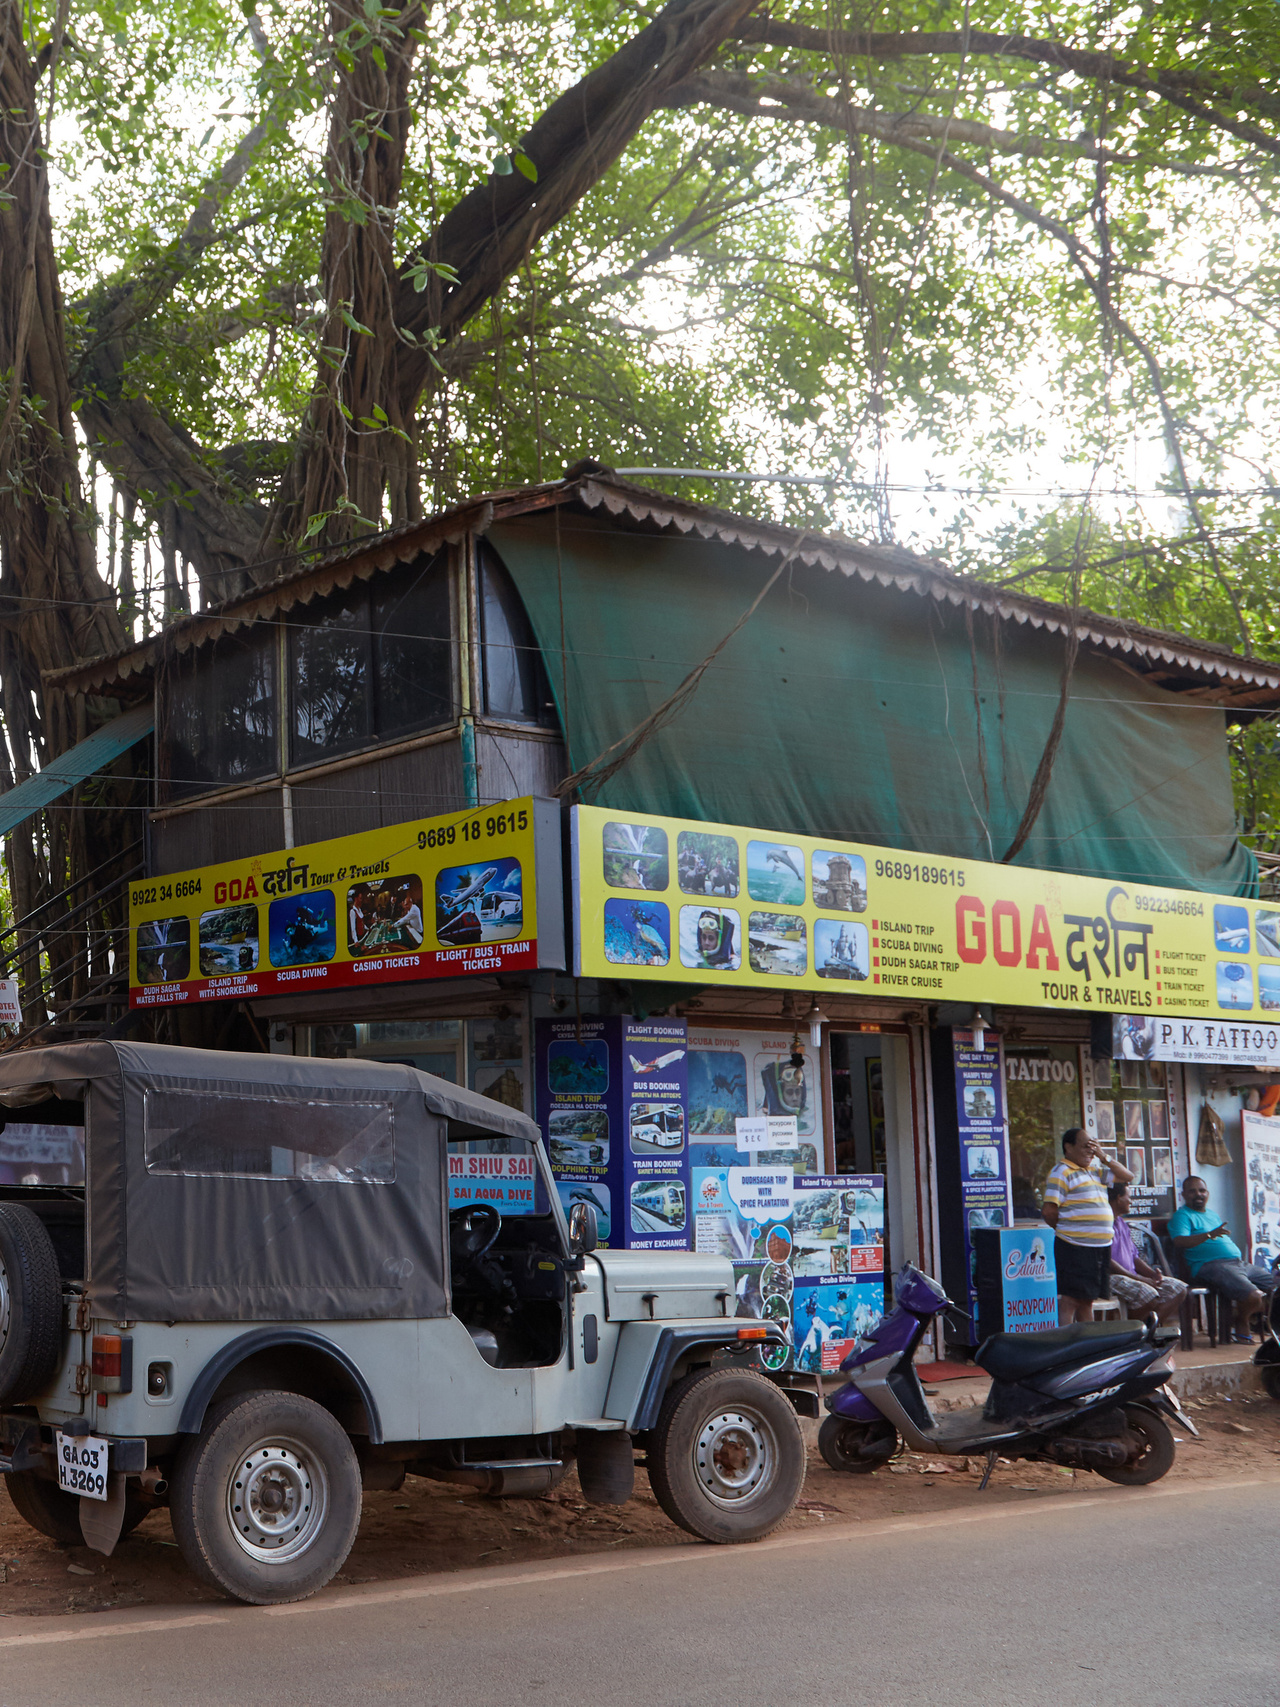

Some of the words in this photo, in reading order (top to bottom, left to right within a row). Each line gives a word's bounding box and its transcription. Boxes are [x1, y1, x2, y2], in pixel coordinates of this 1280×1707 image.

[418, 826, 455, 850] 9689
[462, 820, 480, 841] 18
[486, 810, 527, 837] 9615
[310, 871, 334, 886] Tour
[337, 868, 347, 880] &
[349, 860, 390, 879] Travels
[875, 859, 965, 887] 9689189615
[214, 876, 259, 904] GOA
[262, 857, 309, 896] दर्शन
[133, 888, 157, 906] 9922
[160, 884, 172, 901] 34
[175, 878, 202, 898] 6664
[1135, 895, 1204, 917] 9922346664
[880, 921, 912, 934] ISLAND
[915, 925, 935, 936] TRIP
[955, 894, 1060, 971] GOA
[1063, 885, 1154, 982] दर्शन
[435, 949, 469, 962] FLIGHT
[474, 946, 493, 958] BUS
[500, 942, 530, 956] TRAIN
[880, 938, 911, 951] SCUBA
[913, 942, 943, 954] DIVING
[1162, 951, 1183, 960] FLIGHT
[1185, 952, 1206, 962] TICKET
[353, 961, 383, 973] CASINO
[385, 955, 420, 969] TICKETS
[462, 957, 502, 971] TICKETS
[881, 956, 907, 968] DUDH
[909, 958, 938, 971] SAGAR
[940, 961, 960, 972] TRIP
[1163, 966, 1175, 975] BUS
[1177, 967, 1198, 976] TICKET
[208, 977, 232, 988] ISLAND
[233, 975, 248, 985] TRIP
[276, 971, 301, 982] SCUBA
[302, 967, 328, 979] DIVING
[882, 974, 909, 986] RIVER
[911, 976, 943, 988] CRUISE
[143, 987, 159, 996] DUDH
[161, 984, 181, 993] SAGAR
[199, 989, 216, 999] WITH
[216, 984, 258, 997] SNORKELING
[1164, 982, 1182, 990] TRAIN
[1183, 983, 1204, 992] TICKET
[136, 995, 156, 1005] WATER
[157, 993, 174, 1003] FALLS
[175, 992, 189, 1000] TRIP
[1041, 982, 1080, 1000] TOUR
[1083, 986, 1092, 1002] &
[1096, 987, 1153, 1007] TRAVELS
[1165, 997, 1187, 1006] CASINO
[1188, 999, 1209, 1007] TICKET
[0, 1012, 17, 1020] ONLY
[551, 1024, 577, 1032] SCUBA
[627, 1025, 652, 1034] FLIGHT
[653, 1026, 685, 1036] BOOKING
[688, 1037, 713, 1046] SCUBA
[714, 1038, 740, 1047] DIVING
[1161, 1023, 1176, 1045] P.
[1182, 1025, 1199, 1046] K.
[1204, 1026, 1278, 1050] TATTOO
[762, 1040, 787, 1049] ISLAND
[959, 1053, 971, 1061] ONE
[1006, 1058, 1076, 1083] TATTOO
[633, 1082, 648, 1090] BUS
[649, 1082, 680, 1091] BOOKING
[1083, 1050, 1095, 1127] TATTOO
[555, 1094, 583, 1102] ISLAND
[583, 1095, 602, 1103] TRIP
[449, 1157, 463, 1174] M
[508, 1158, 533, 1175] SAI
[551, 1164, 589, 1174] DOLPHINC
[590, 1166, 608, 1175] TRIP
[632, 1160, 653, 1168] TRAIN
[653, 1159, 683, 1168] BOOKING
[1173, 1138, 1182, 1202] STUDI
[741, 1176, 774, 1185] DUDHSAGAR
[775, 1176, 788, 1185] TRIP
[801, 1178, 820, 1186] Island
[820, 1179, 833, 1187] Trip
[833, 1178, 846, 1186] with
[454, 1187, 471, 1199] SAI
[474, 1188, 504, 1200] AQUA
[508, 1189, 532, 1201] DIVE
[758, 1187, 772, 1196] WITH
[1140, 1187, 1168, 1196] TEMPORARY
[739, 1199, 756, 1208] SPICE
[757, 1198, 789, 1208] PLANTATION
[1139, 1206, 1152, 1214] SAFE
[630, 1240, 653, 1249] MONEY
[654, 1239, 687, 1248] EXCHANGE
[1005, 1251, 1045, 1279] Edana
[820, 1276, 838, 1285] Scuba
[838, 1275, 857, 1284] Diving
[1007, 1297, 1056, 1317] ЭКСКУРСИИ
[63, 1444, 99, 1470] GA.03
[60, 1464, 105, 1496] H.3269
